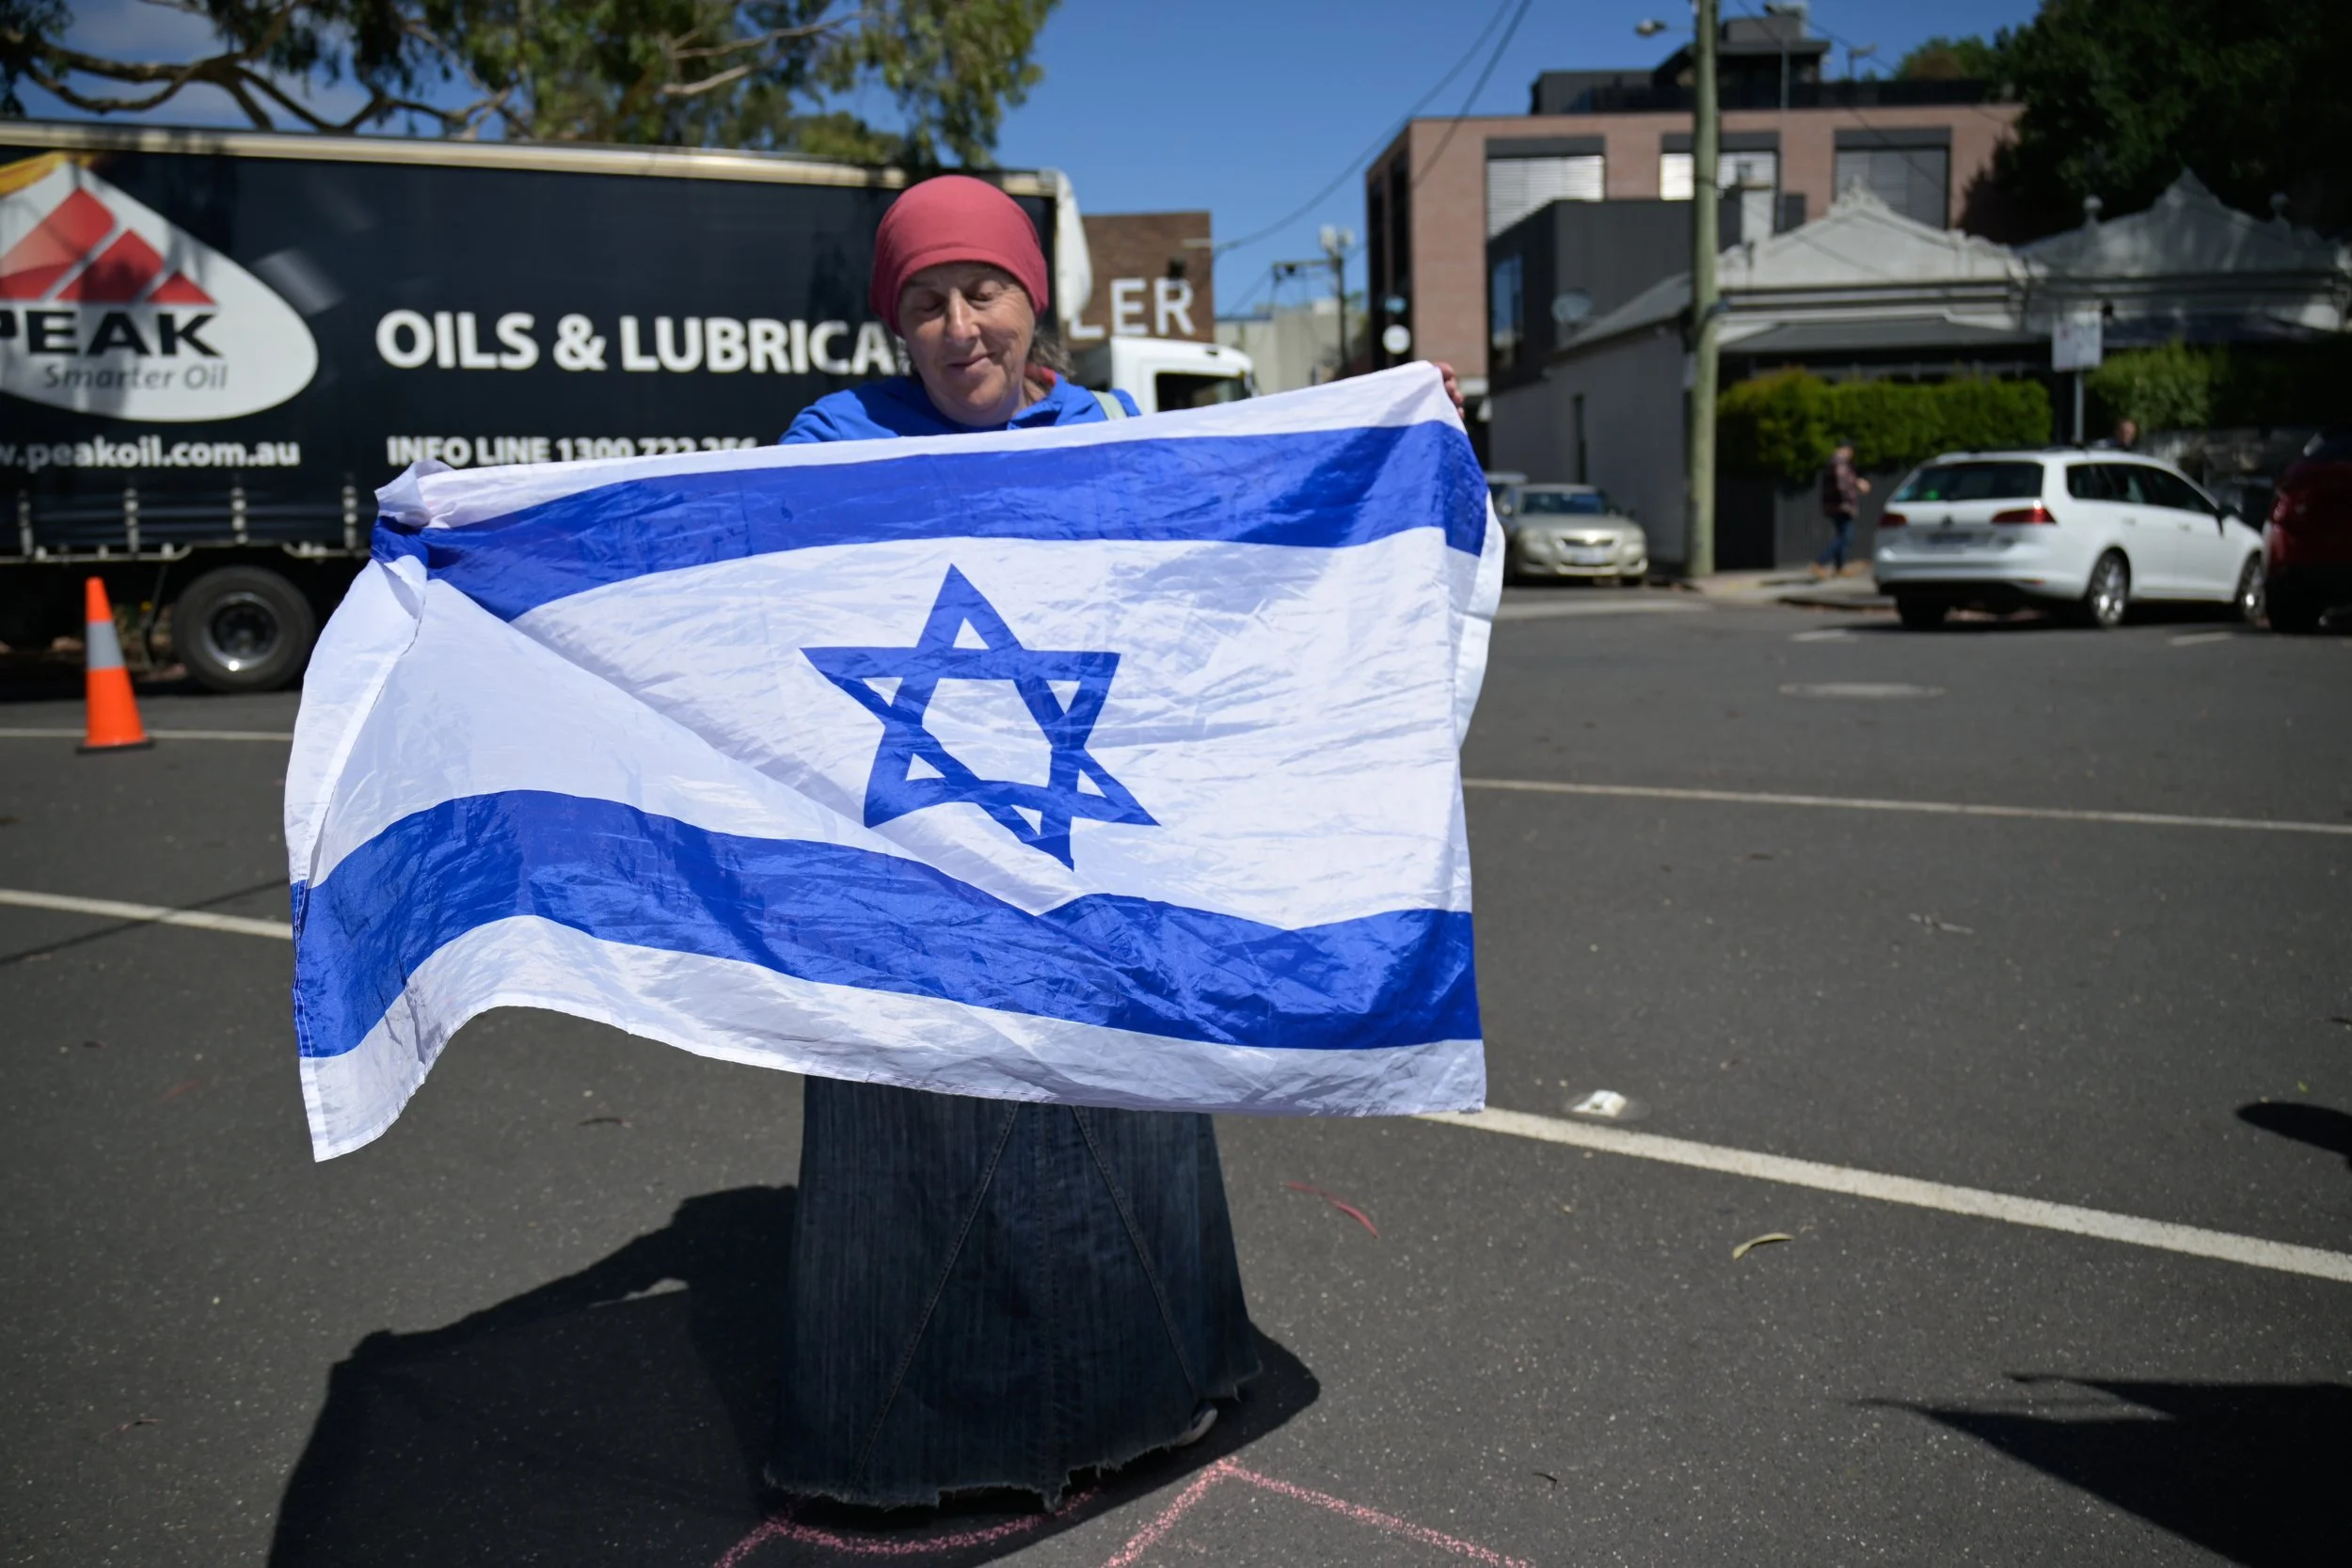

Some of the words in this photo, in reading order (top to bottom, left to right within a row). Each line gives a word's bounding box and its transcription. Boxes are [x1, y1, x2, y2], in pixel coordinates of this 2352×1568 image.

[375, 309, 539, 370] OILS
[553, 313, 608, 372] &
[619, 315, 911, 375] LUBRICA
[43, 363, 176, 389] Smarter
[183, 363, 229, 389] Oil
[387, 436, 471, 467] INFO
[475, 436, 551, 465] LINE
[556, 436, 635, 462] 1300
